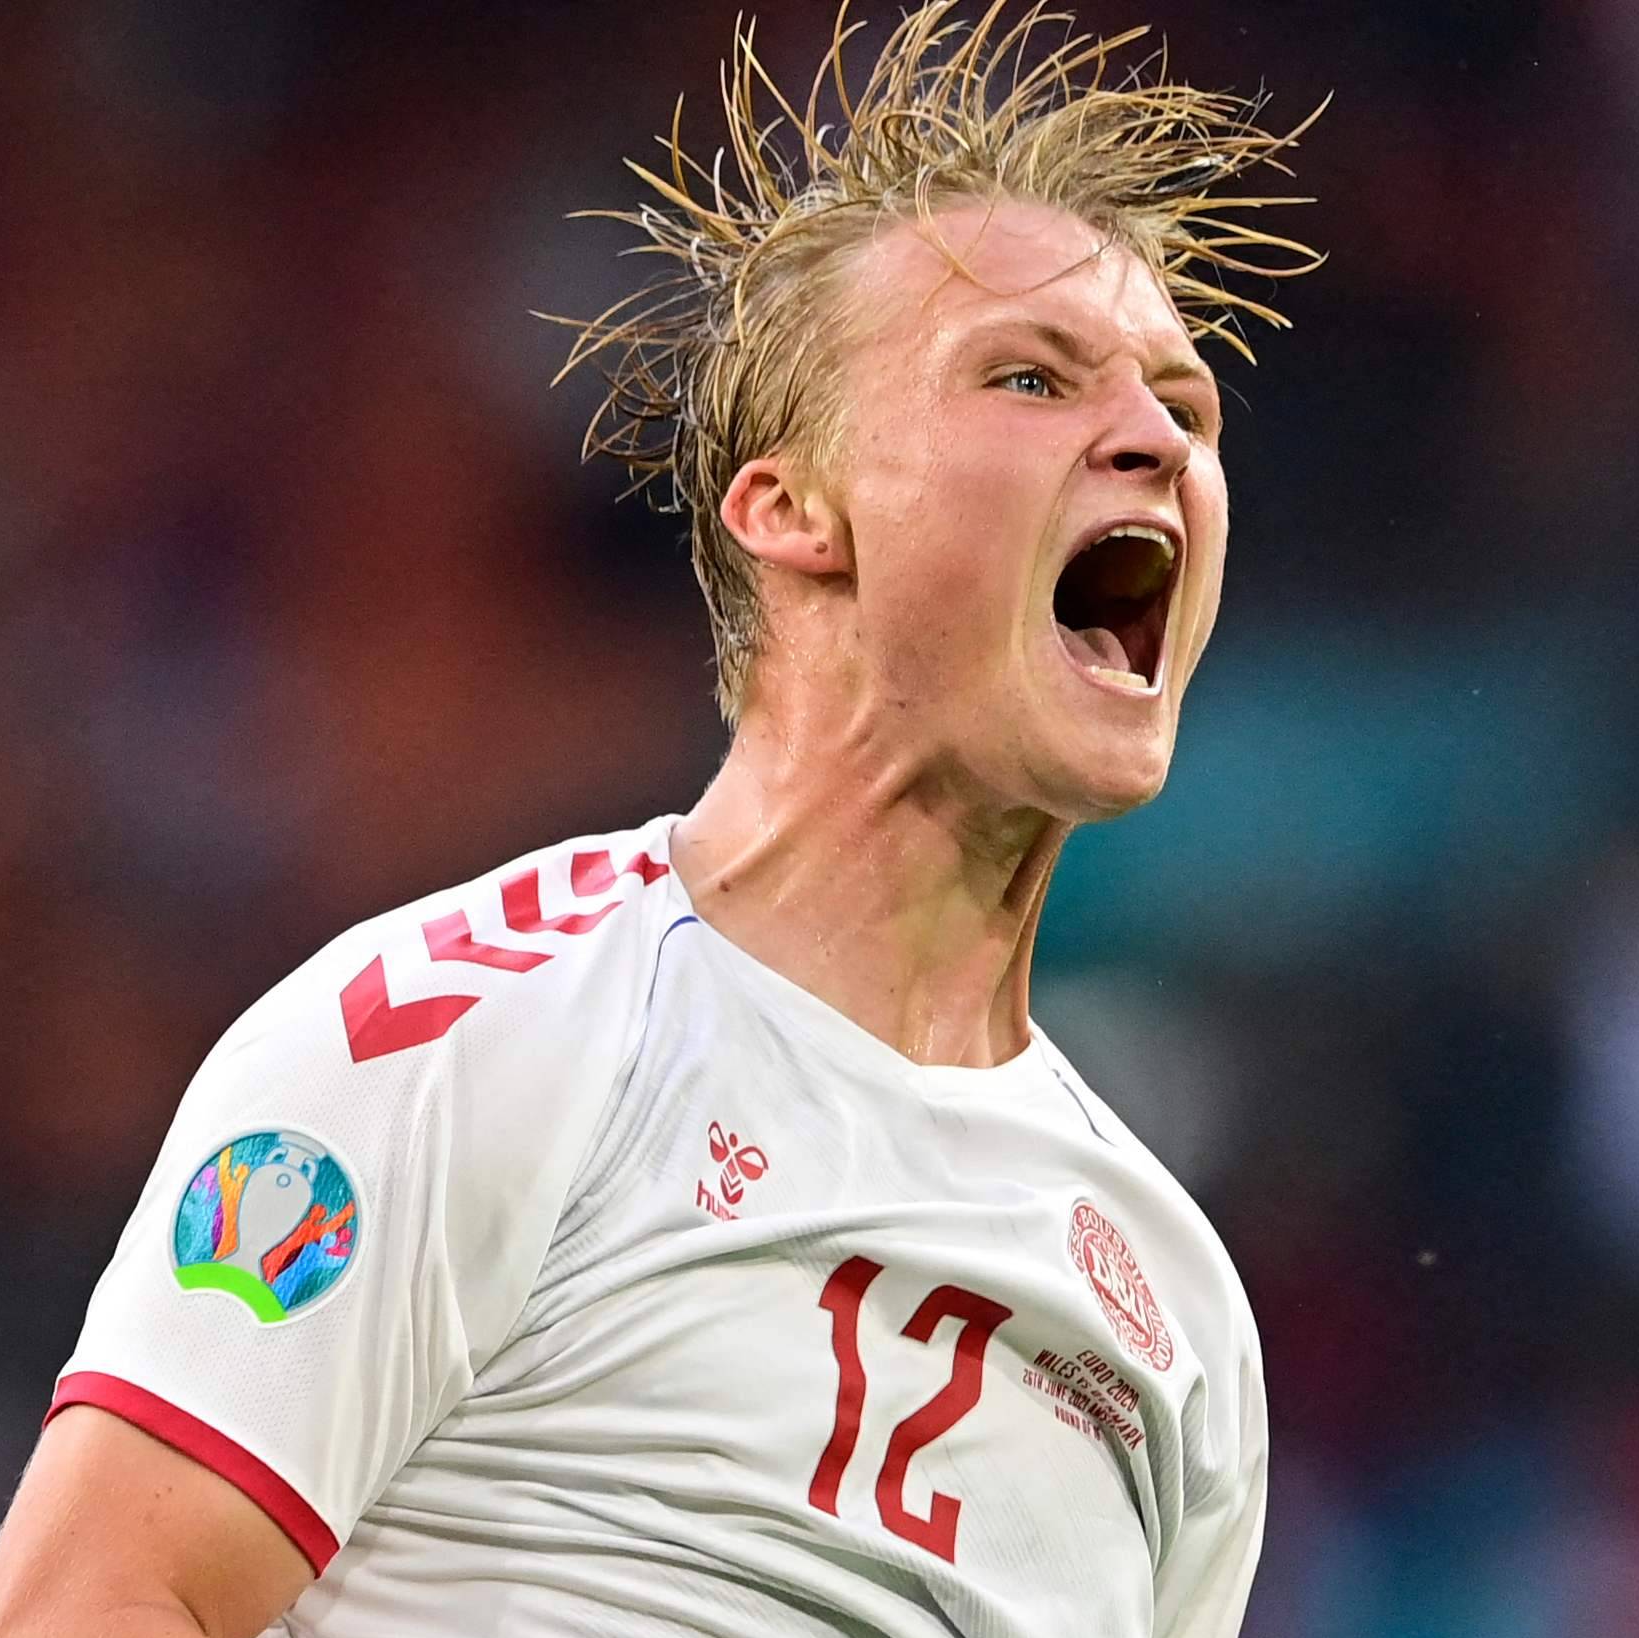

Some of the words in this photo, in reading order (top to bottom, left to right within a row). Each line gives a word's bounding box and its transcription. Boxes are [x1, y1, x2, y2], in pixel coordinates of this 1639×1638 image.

[1022, 1368, 1044, 1390] 26TH
[1044, 1378, 1068, 1402] JUNE
[1067, 1388, 1091, 1413] 2021
[1033, 1349, 1081, 1379] WALES
[1076, 1349, 1115, 1384] EURO
[1106, 1378, 1141, 1412] 2020
[808, 1255, 1014, 1565] 12
